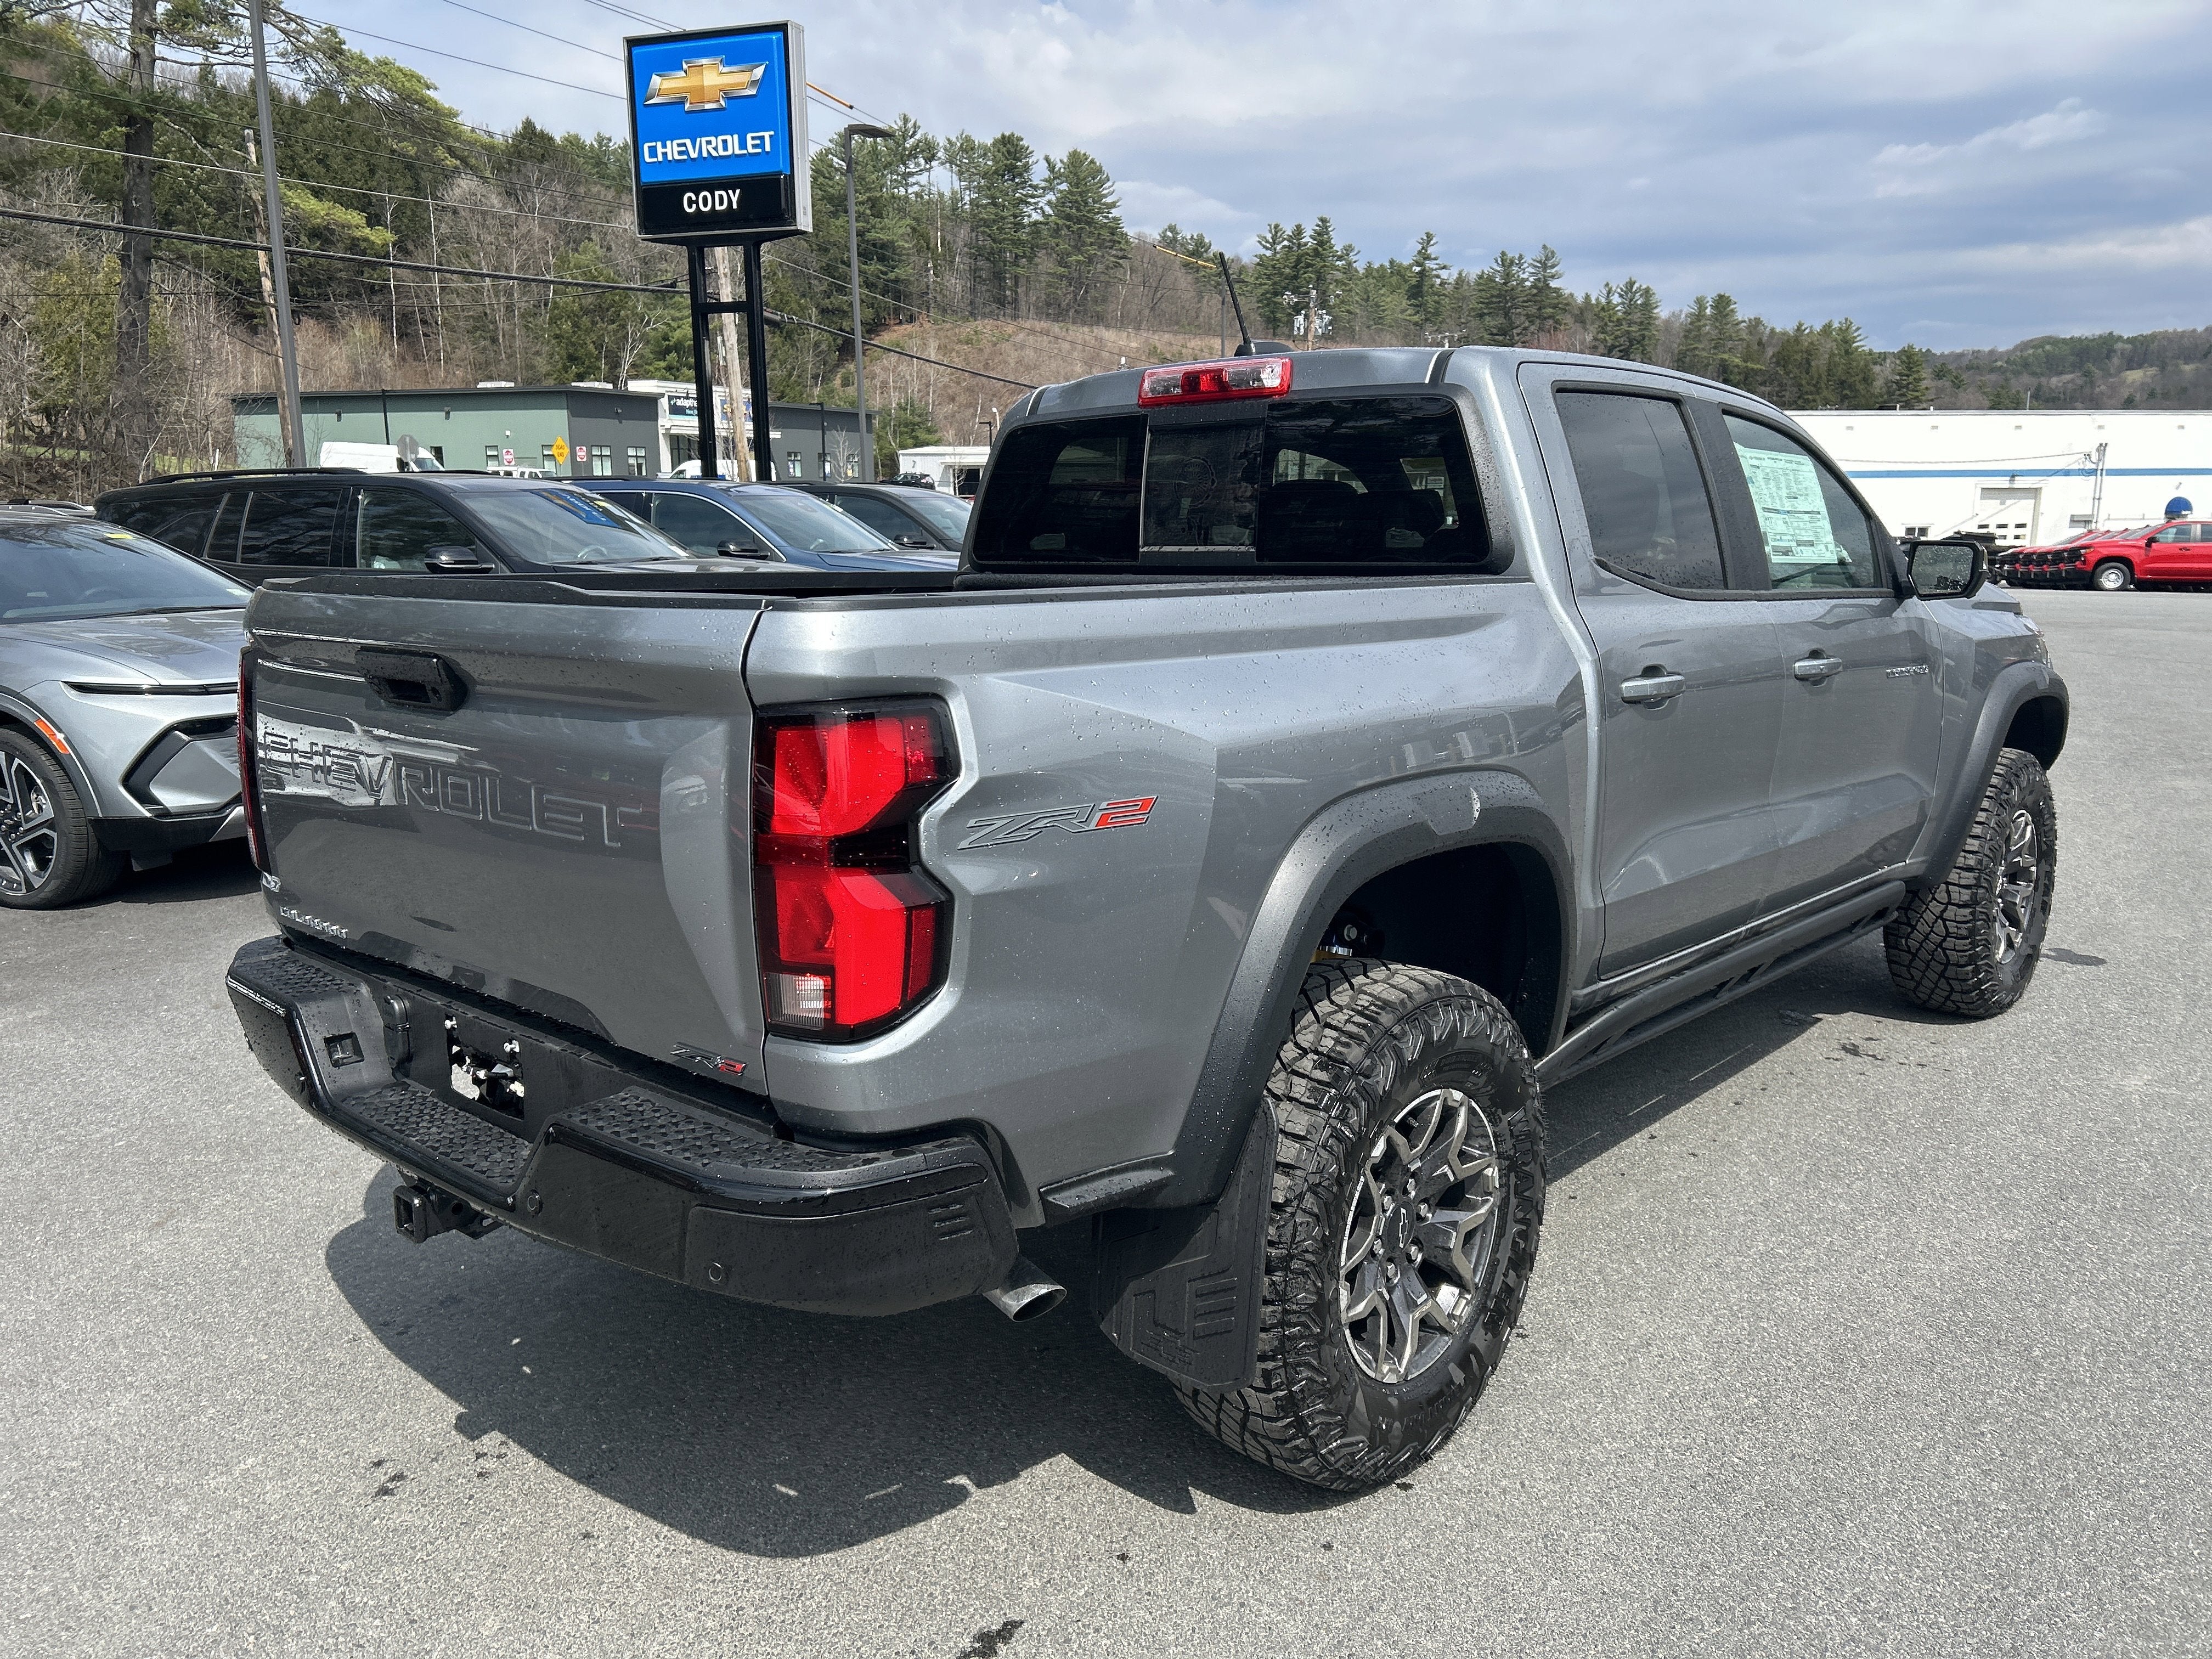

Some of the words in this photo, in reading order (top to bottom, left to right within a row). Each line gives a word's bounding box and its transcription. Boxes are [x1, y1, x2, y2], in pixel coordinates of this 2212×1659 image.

[644, 131, 774, 163] CHEVROLET
[683, 189, 741, 213] CODY
[260, 732, 643, 847] CHEVROLET
[957, 795, 1158, 850] ZR2
[670, 1042, 747, 1076] ZR2
[1482, 1105, 1536, 1339] WRANGLER
